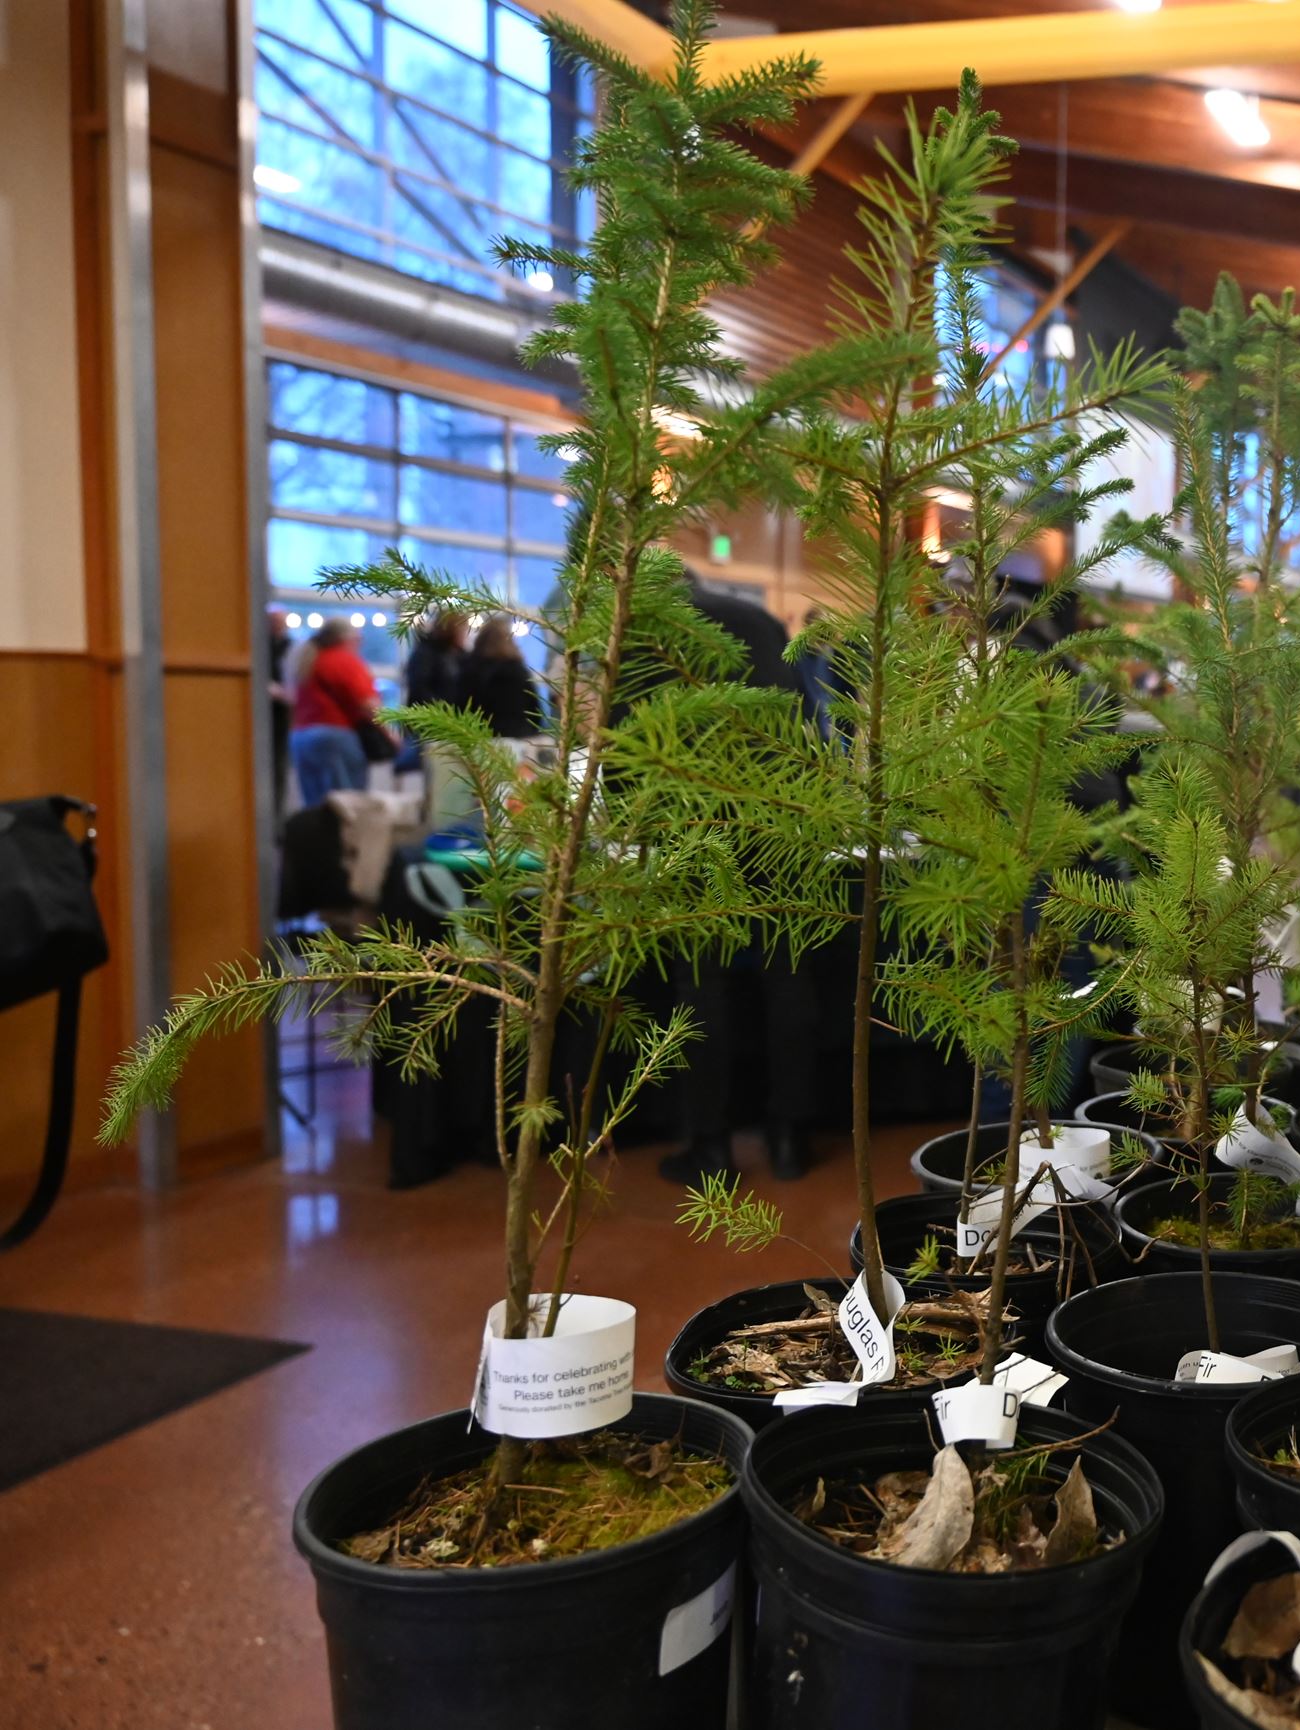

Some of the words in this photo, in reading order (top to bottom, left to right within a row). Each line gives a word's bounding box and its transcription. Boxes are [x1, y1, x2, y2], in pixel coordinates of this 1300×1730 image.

[494, 1370, 529, 1384] Thanks
[532, 1372, 549, 1384] for
[553, 1359, 618, 1382] celebrating
[514, 1389, 554, 1401] Please
[558, 1384, 585, 1399] take
[588, 1380, 606, 1392] me
